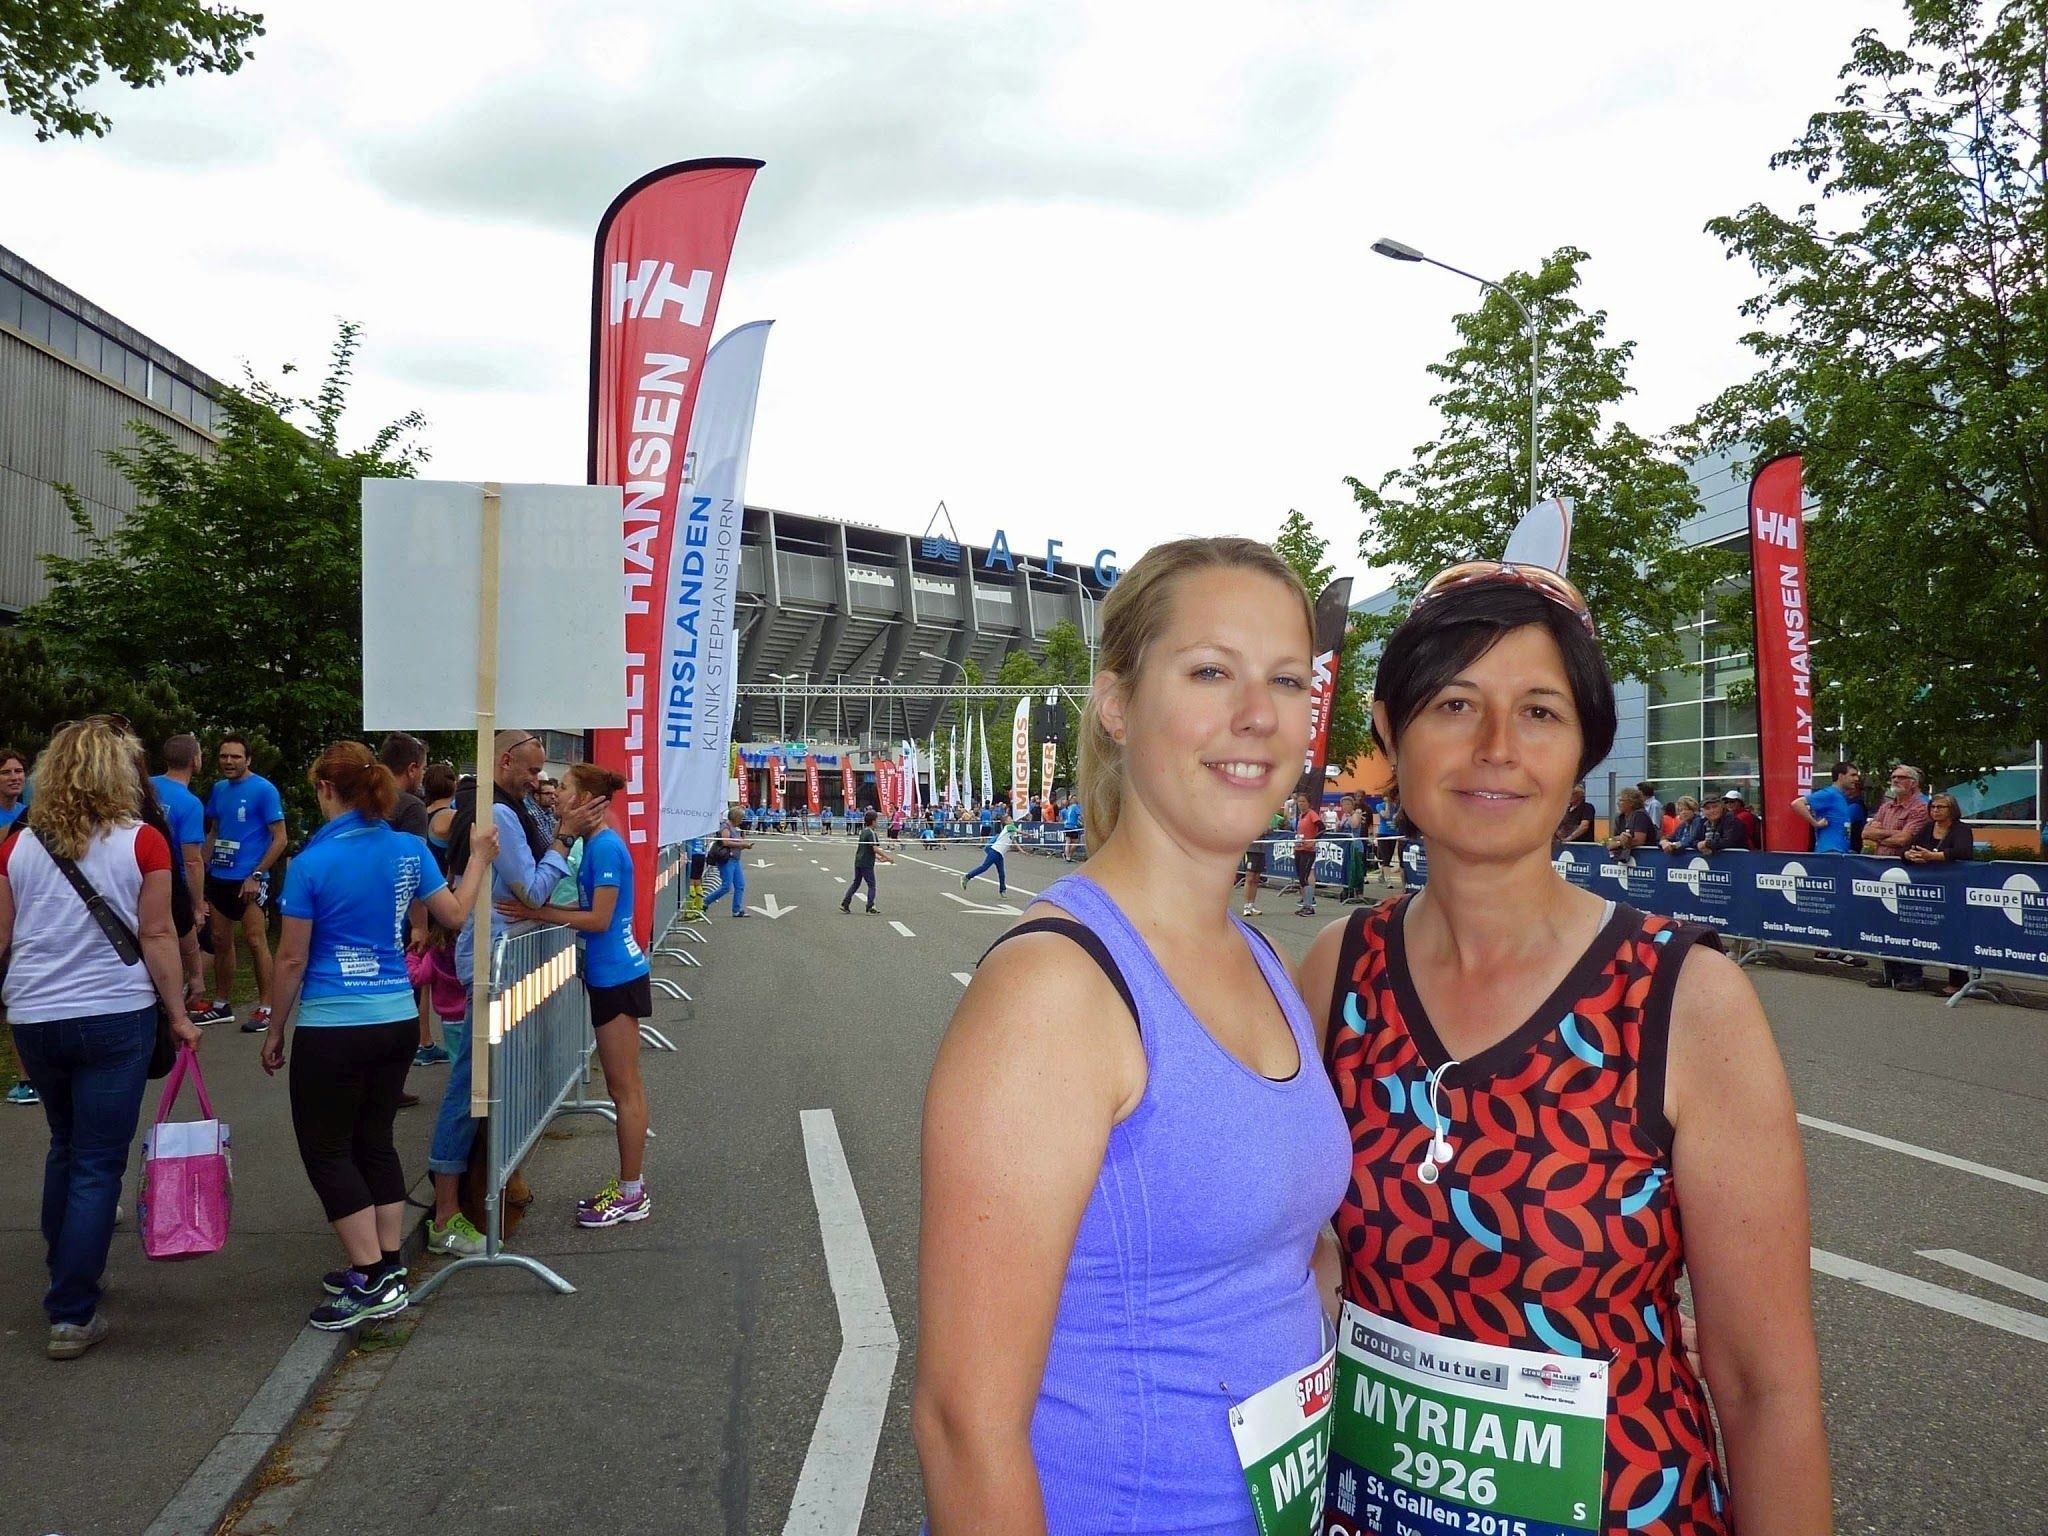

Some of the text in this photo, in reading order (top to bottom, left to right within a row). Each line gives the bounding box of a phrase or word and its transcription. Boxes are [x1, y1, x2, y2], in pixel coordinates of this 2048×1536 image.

[666, 496, 712, 748] HIRSLANDEN
[703, 499, 735, 751] KLINIK STEPHANSHORN
[1779, 564, 1813, 799] ELLY HANSEN
[1320, 691, 1331, 733] MIGROS
[1016, 717, 1028, 810] MIGROS
[1601, 865, 1654, 878] Groupe Mutuel
[1669, 869, 1729, 883] Groupe Mutuel
[1758, 875, 1833, 890] Groupe Mutuel
[1854, 881, 1941, 899] Groupe Mutuel
[1969, 890, 2018, 907] Groupe
[1690, 913, 1709, 923] Power
[1763, 921, 1833, 937] Swiss Power Group.
[1860, 931, 1941, 950] Swiss Power Group.
[1974, 945, 2003, 957] Swiss
[2005, 948, 2037, 961] Power
[1354, 1327, 1501, 1383] Groupe Mutuel
[1522, 1368, 1580, 1382] Groupe Mutuel
[1353, 1373, 1562, 1469] MYRIAM
[1391, 1443, 1497, 1506] 2926
[1367, 1476, 1526, 1536] St. Gallen 2015
[1573, 1502, 1586, 1521] S
